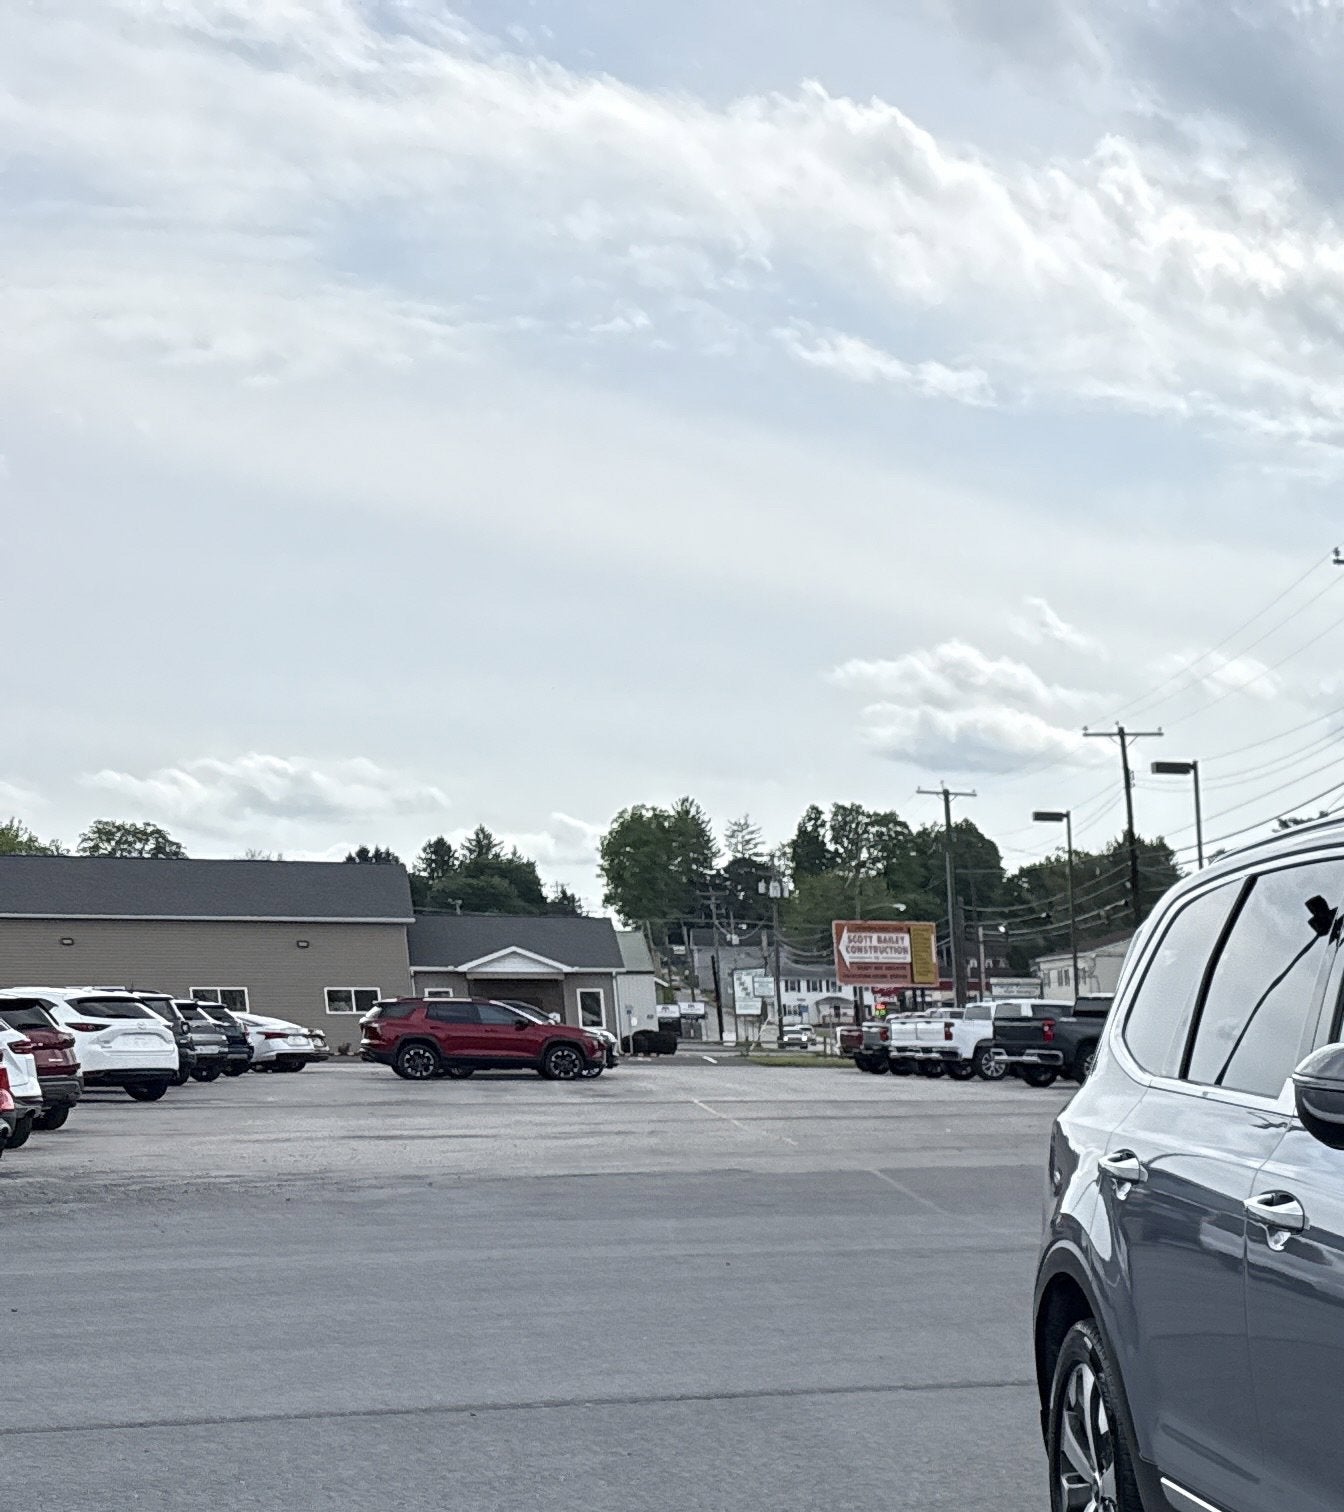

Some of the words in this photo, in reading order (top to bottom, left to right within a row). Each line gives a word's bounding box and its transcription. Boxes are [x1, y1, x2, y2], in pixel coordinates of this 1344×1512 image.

[847, 934, 873, 945] SCOTT
[877, 934, 905, 945] BAILEY
[846, 945, 909, 955] CONSTRUCTION
